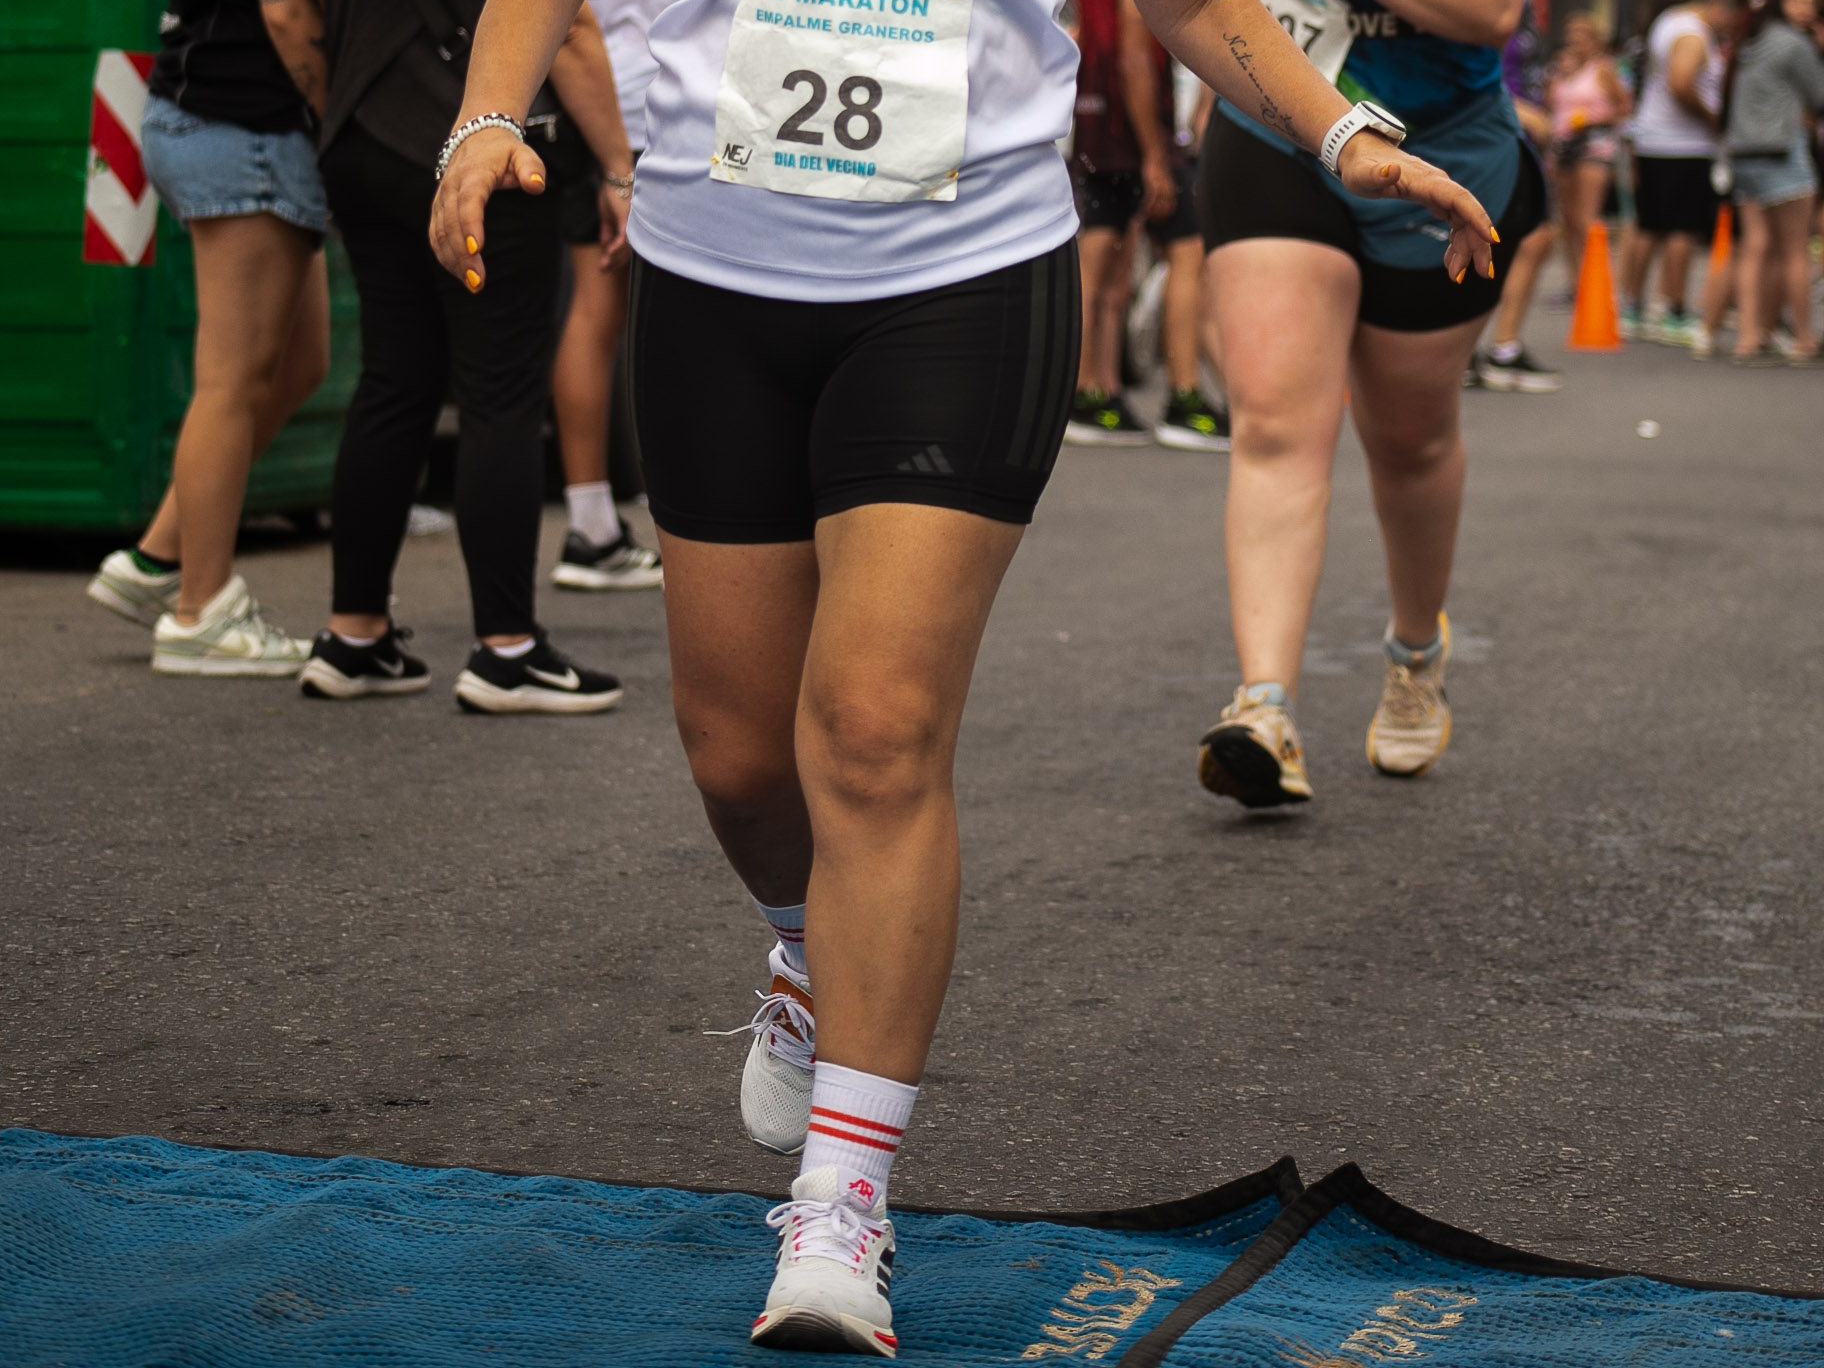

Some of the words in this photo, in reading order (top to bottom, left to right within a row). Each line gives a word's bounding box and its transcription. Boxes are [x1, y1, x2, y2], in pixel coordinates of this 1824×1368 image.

[756, 8, 833, 33] EMPALME
[838, 20, 936, 45] GRANEROS
[775, 68, 884, 152] 28
[722, 142, 753, 166] NEJ
[774, 151, 796, 170] DIA
[799, 153, 824, 173] DEL
[826, 157, 877, 177] VECINO
